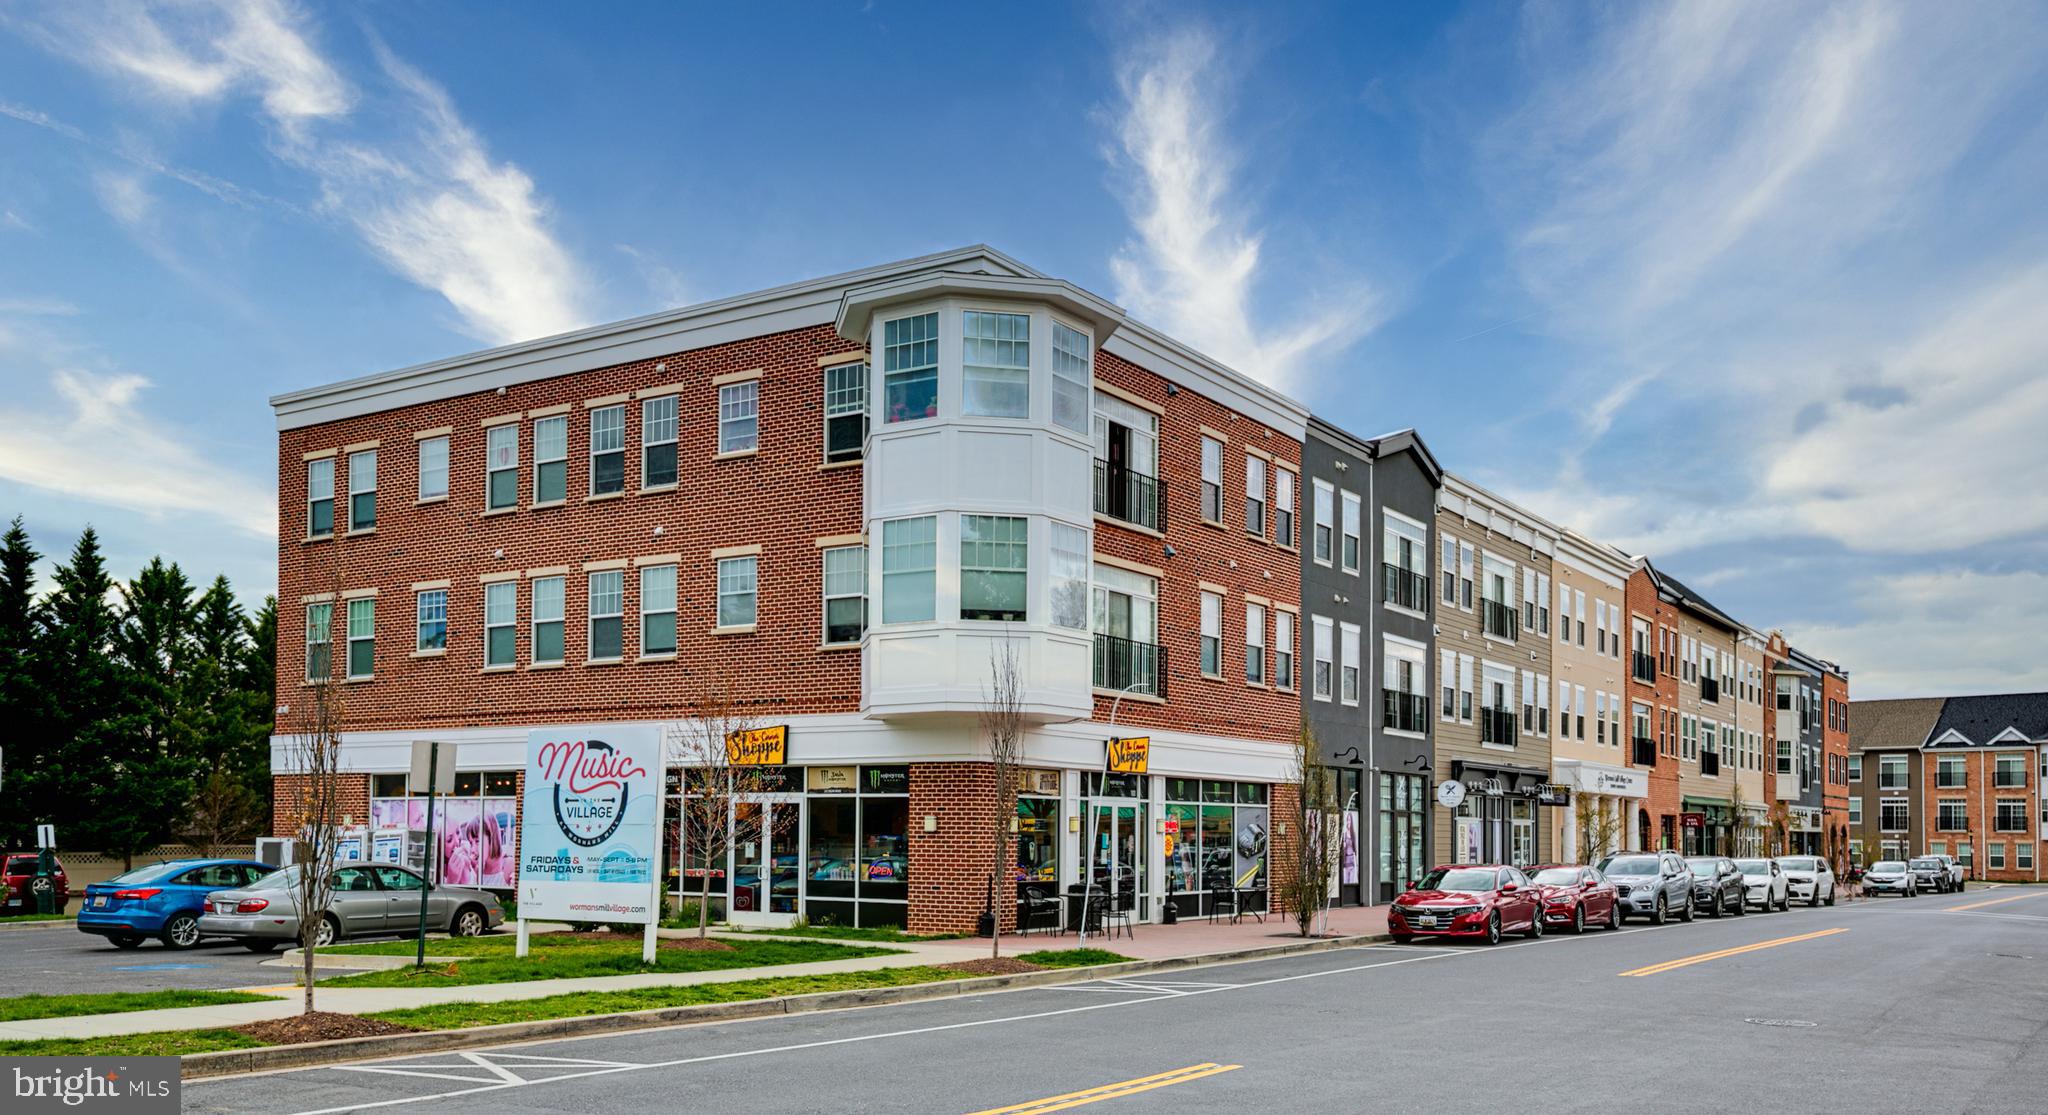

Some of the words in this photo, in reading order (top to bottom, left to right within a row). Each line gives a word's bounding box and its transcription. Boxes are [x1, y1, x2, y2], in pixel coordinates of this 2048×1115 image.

[726, 730, 782, 764] Shoppe
[1112, 737, 1147, 771] Shoppe
[538, 741, 646, 794] Music
[665, 775, 679, 784] GN
[566, 806, 613, 818] VILLAGE
[531, 856, 571, 864] FRIDAYS
[526, 864, 584, 874] SATURDAYS
[868, 865, 893, 876] OPEN
[569, 903, 646, 914] wormansmillvillage.com
